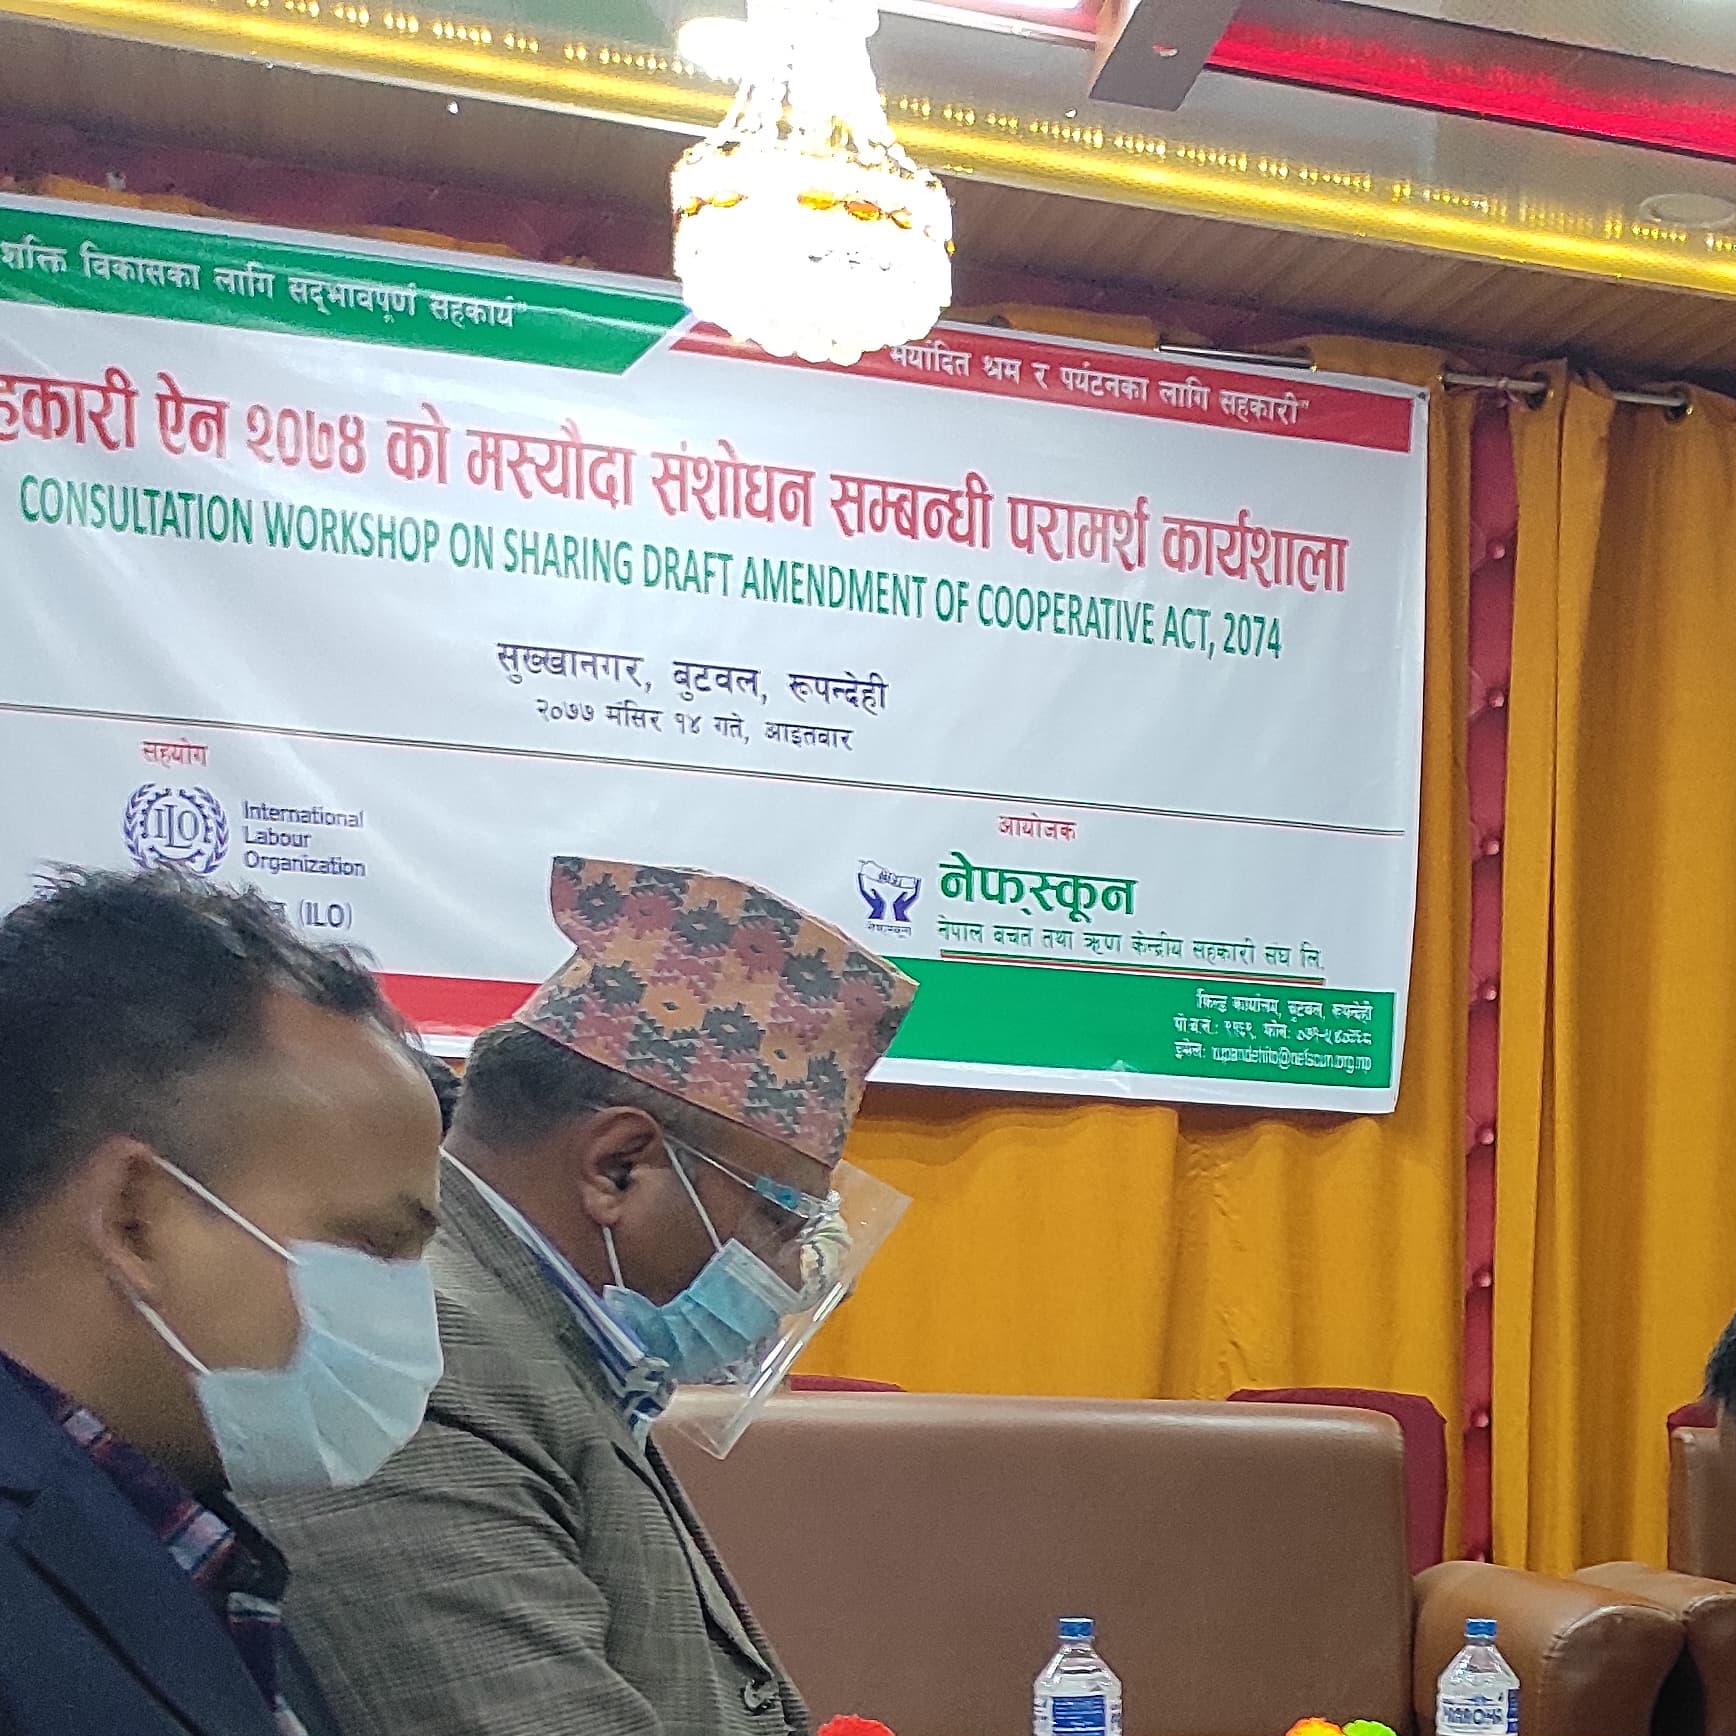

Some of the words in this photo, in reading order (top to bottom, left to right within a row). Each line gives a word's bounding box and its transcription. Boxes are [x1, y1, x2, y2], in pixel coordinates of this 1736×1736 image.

[79, 240, 201, 291] विकासका
[213, 260, 276, 300] लागि
[982, 355, 1023, 385] श्रम
[1031, 362, 1050, 390] र
[1059, 361, 1150, 401] पर्यटनका
[1158, 376, 1211, 412] लागि
[155, 371, 230, 459] ऐन
[246, 404, 367, 474] २०७४
[386, 402, 452, 485] को
[466, 417, 637, 509] मस्यौदा
[650, 438, 817, 528] संशोधन
[829, 471, 996, 549] सम्बन्धी
[1007, 496, 1149, 572] परामर्श
[1161, 508, 1350, 593] कार्यशाला
[19, 474, 253, 544] CONSULTATION
[262, 499, 440, 564] WORKSHOP
[449, 521, 494, 570] ON
[503, 527, 634, 586] SHARING
[643, 544, 734, 597] DRAFT
[742, 555, 928, 619] AMENDMENT
[935, 578, 971, 624] OF
[977, 582, 1156, 646] COOPERATIVE
[1161, 604, 1215, 660] ACT,
[1222, 610, 1283, 660] 2074
[535, 697, 596, 722] २०७७
[605, 699, 664, 732] मंसिर
[674, 711, 702, 736] १४
[141, 737, 209, 769] सहयोग
[243, 801, 365, 828] International
[998, 811, 1077, 841] आयोजक
[243, 826, 312, 849] Labour
[243, 850, 367, 875] Organization
[299, 898, 353, 929] (ILO)
[936, 915, 985, 944] नेपाल
[1041, 928, 1074, 951] तथा
[1082, 931, 1122, 956] ऋण
[1129, 930, 1184, 957] केन्द्रीय
[1192, 936, 1256, 967] सहकारी
[1263, 943, 1292, 968] संघ
